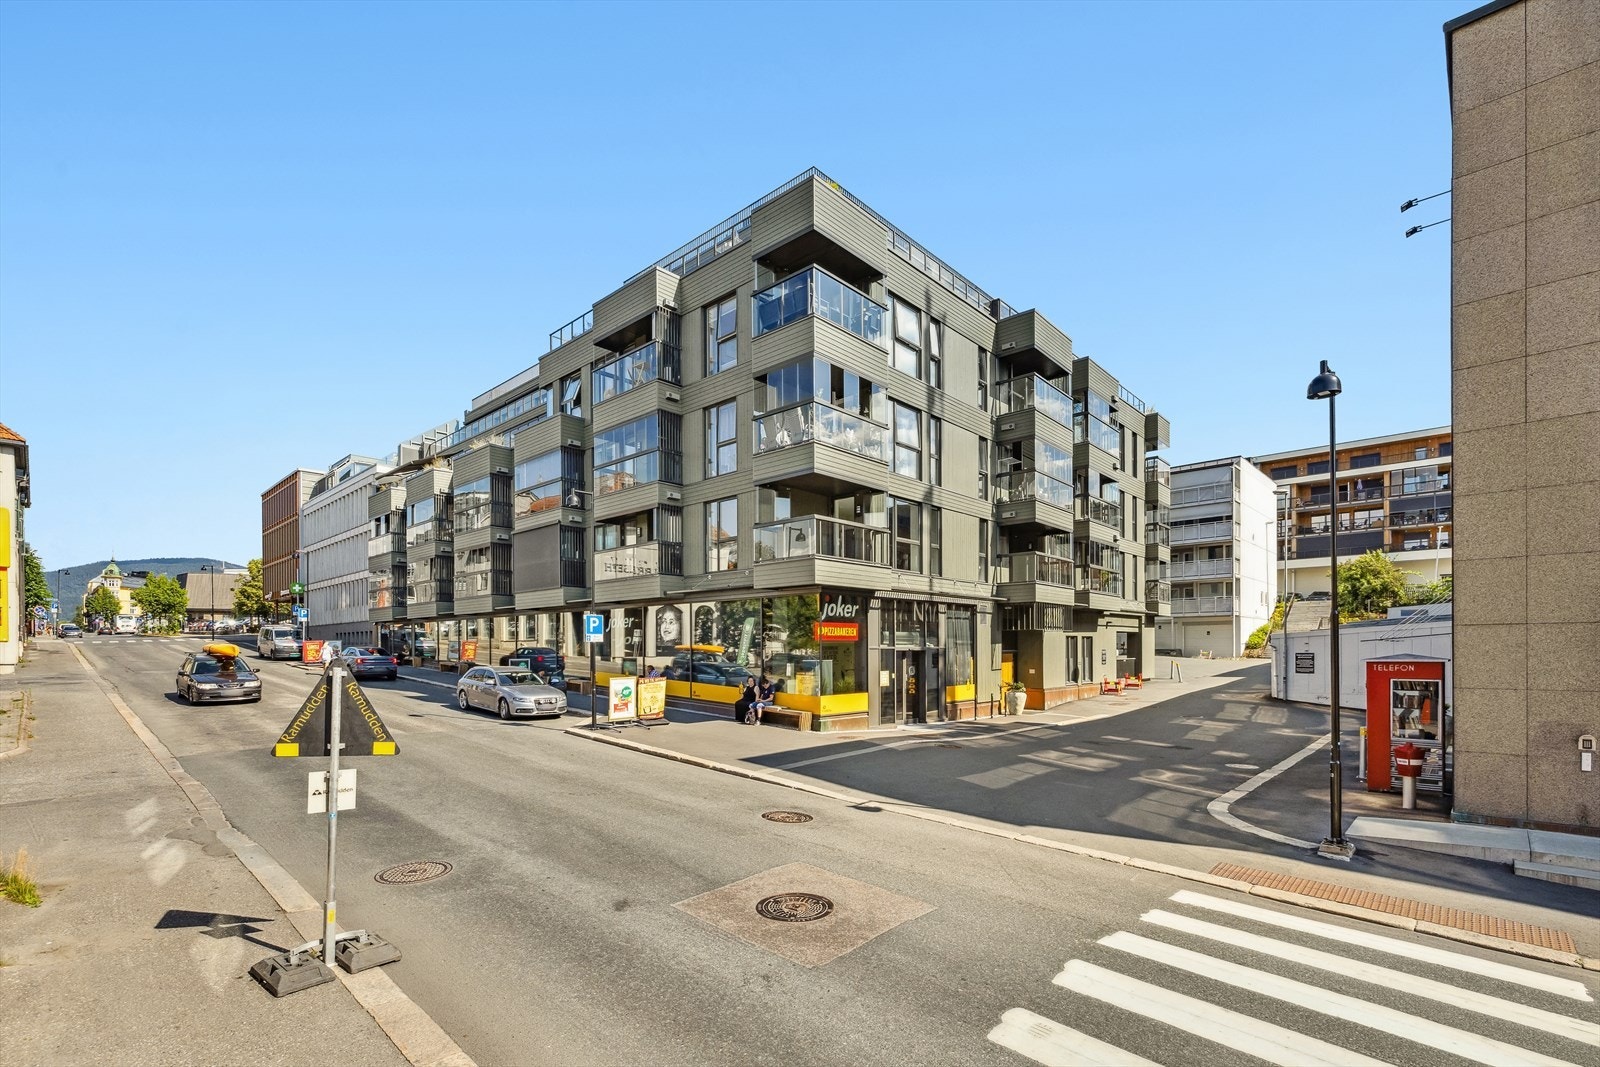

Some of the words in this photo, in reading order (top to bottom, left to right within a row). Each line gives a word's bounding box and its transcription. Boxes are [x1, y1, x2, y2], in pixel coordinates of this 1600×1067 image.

[821, 594, 859, 620] joker
[589, 617, 600, 633] P
[1373, 664, 1415, 672] TELEFON
[280, 684, 330, 743] Ramudden
[346, 681, 387, 742] Ramudden
